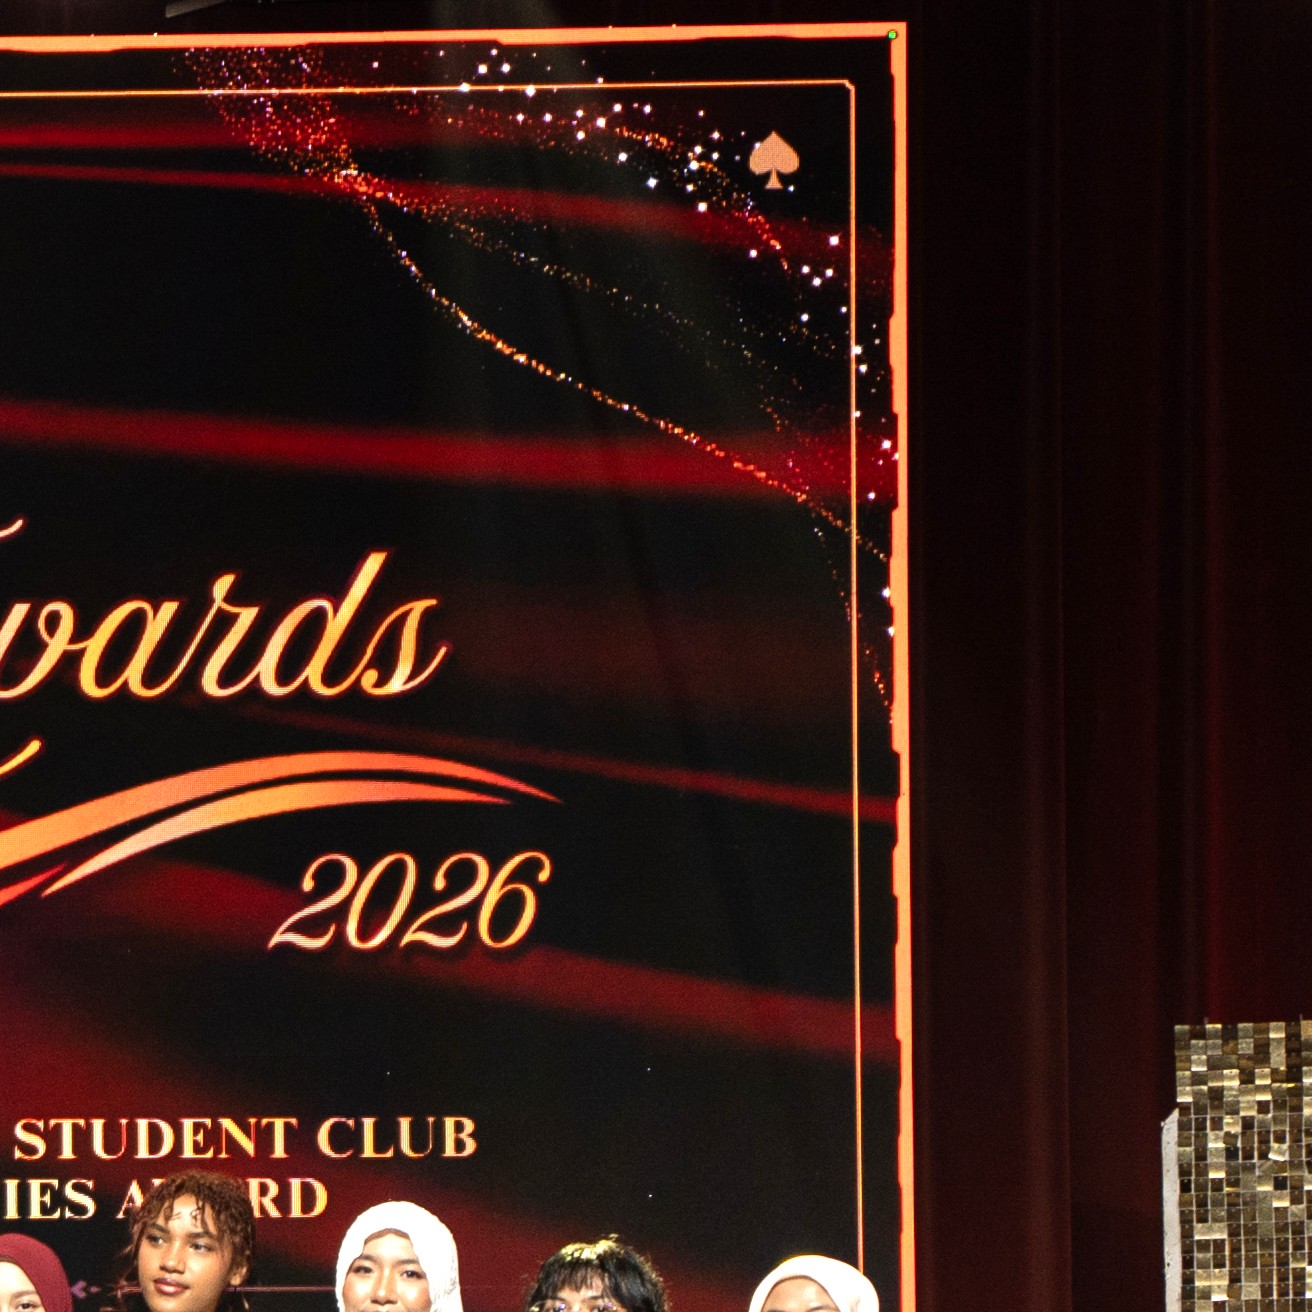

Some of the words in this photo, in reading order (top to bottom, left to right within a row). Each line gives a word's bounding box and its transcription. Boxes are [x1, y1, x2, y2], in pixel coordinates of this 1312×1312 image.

[266, 850, 552, 951] 2026
[14, 1116, 299, 1161] STUDENT
[316, 1115, 478, 1159] CLUB
[115, 1176, 329, 1220] ARD
